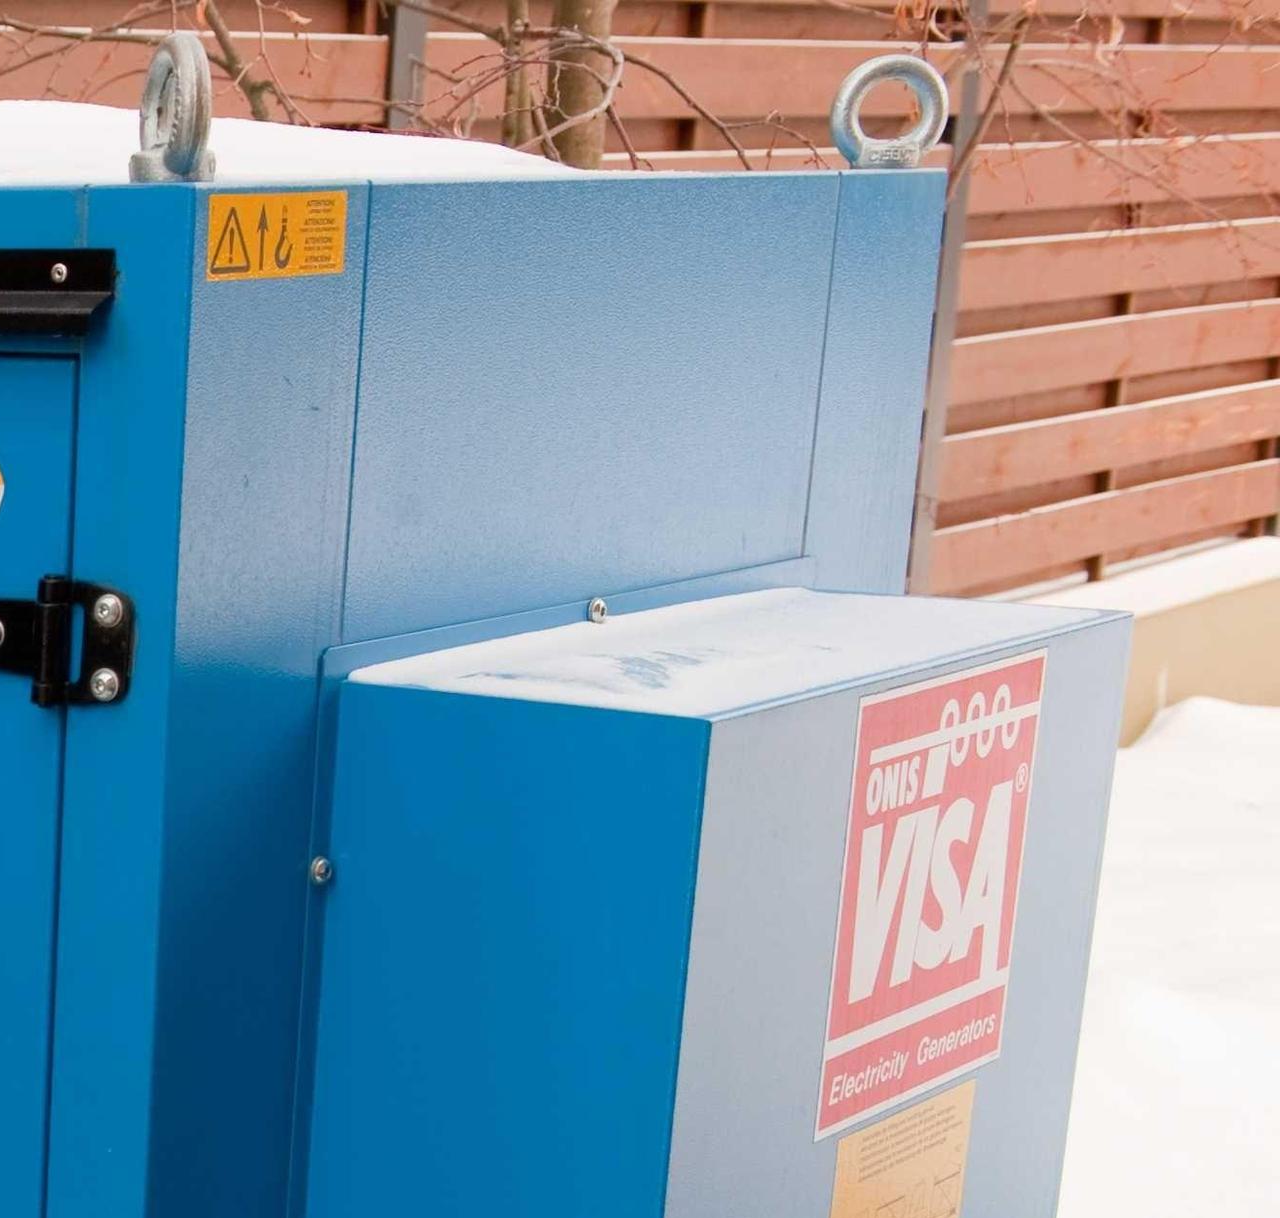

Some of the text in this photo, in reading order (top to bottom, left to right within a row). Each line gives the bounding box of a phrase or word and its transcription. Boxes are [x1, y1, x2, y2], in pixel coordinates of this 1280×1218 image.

[866, 750, 921, 816] ONIS
[849, 780, 1013, 1004] VISA
[829, 1013, 997, 1107] Electricity Generators
